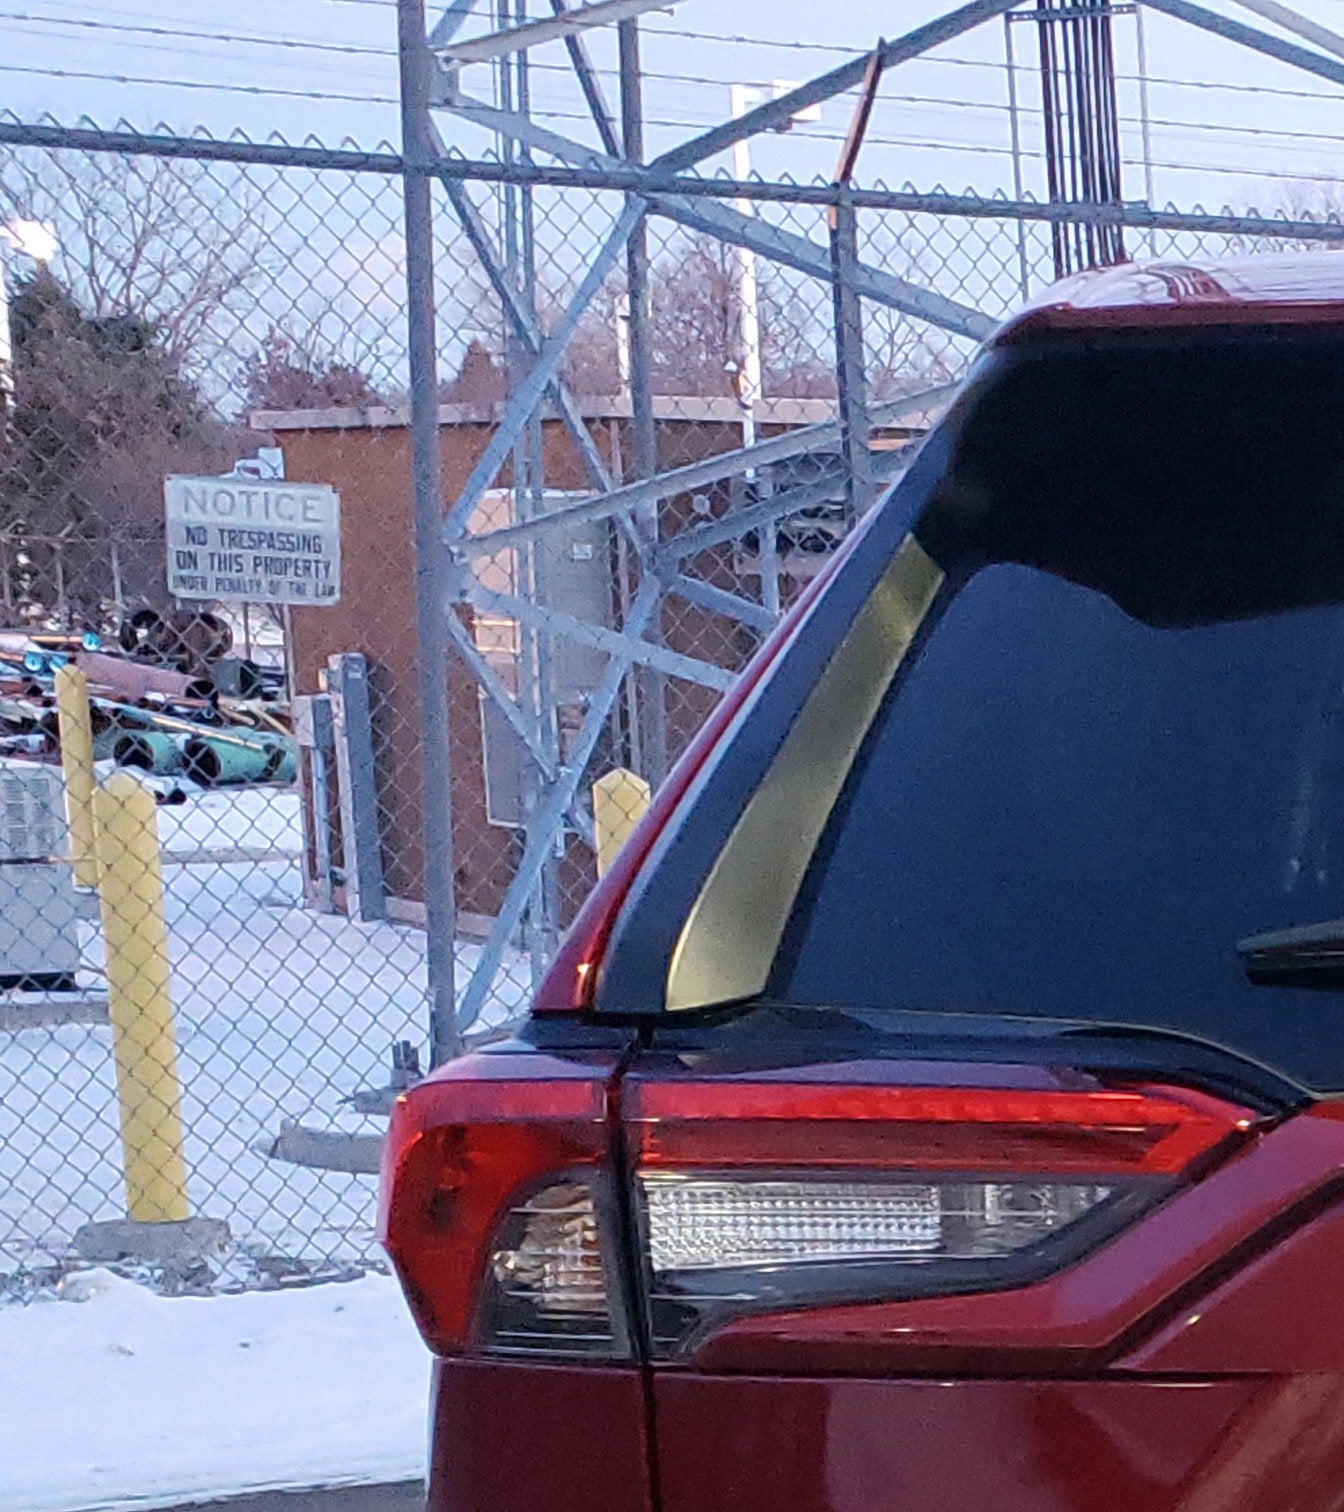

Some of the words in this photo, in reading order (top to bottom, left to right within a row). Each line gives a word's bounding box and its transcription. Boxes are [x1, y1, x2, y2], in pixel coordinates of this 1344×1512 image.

[183, 486, 325, 523] NOTICE
[185, 525, 208, 547] NO
[218, 528, 323, 554] TRESPASSING
[176, 550, 198, 571] ON
[209, 552, 244, 573] THIS
[253, 556, 332, 579] PROPERTY
